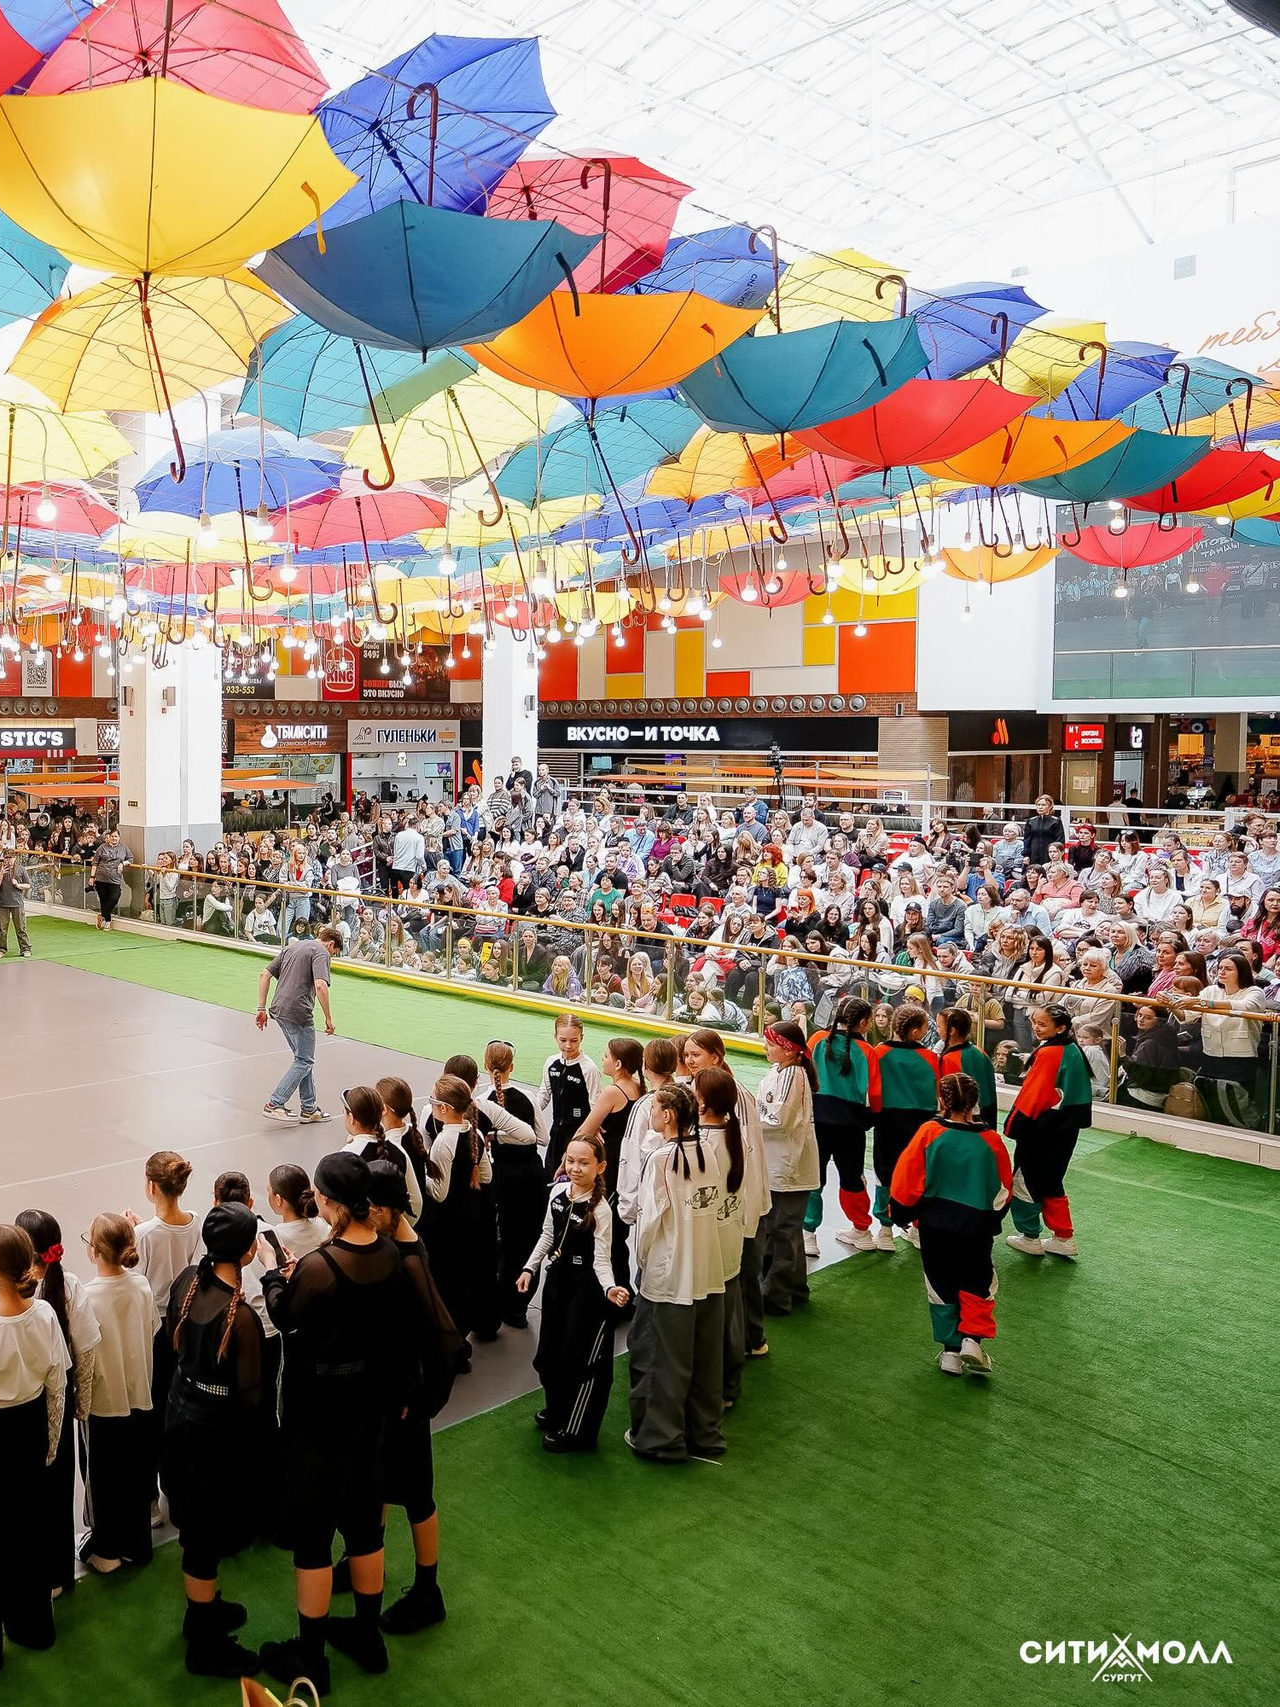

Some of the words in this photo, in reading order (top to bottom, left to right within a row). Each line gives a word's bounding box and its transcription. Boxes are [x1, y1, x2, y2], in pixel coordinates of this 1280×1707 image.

[326, 671, 354, 682] KING
[363, 689, 377, 698] ЭТО
[378, 689, 404, 698] ВКУСНО
[376, 729, 437, 743] ГУЛЕНЬКИ
[660, 726, 720, 742] ТОЧКА
